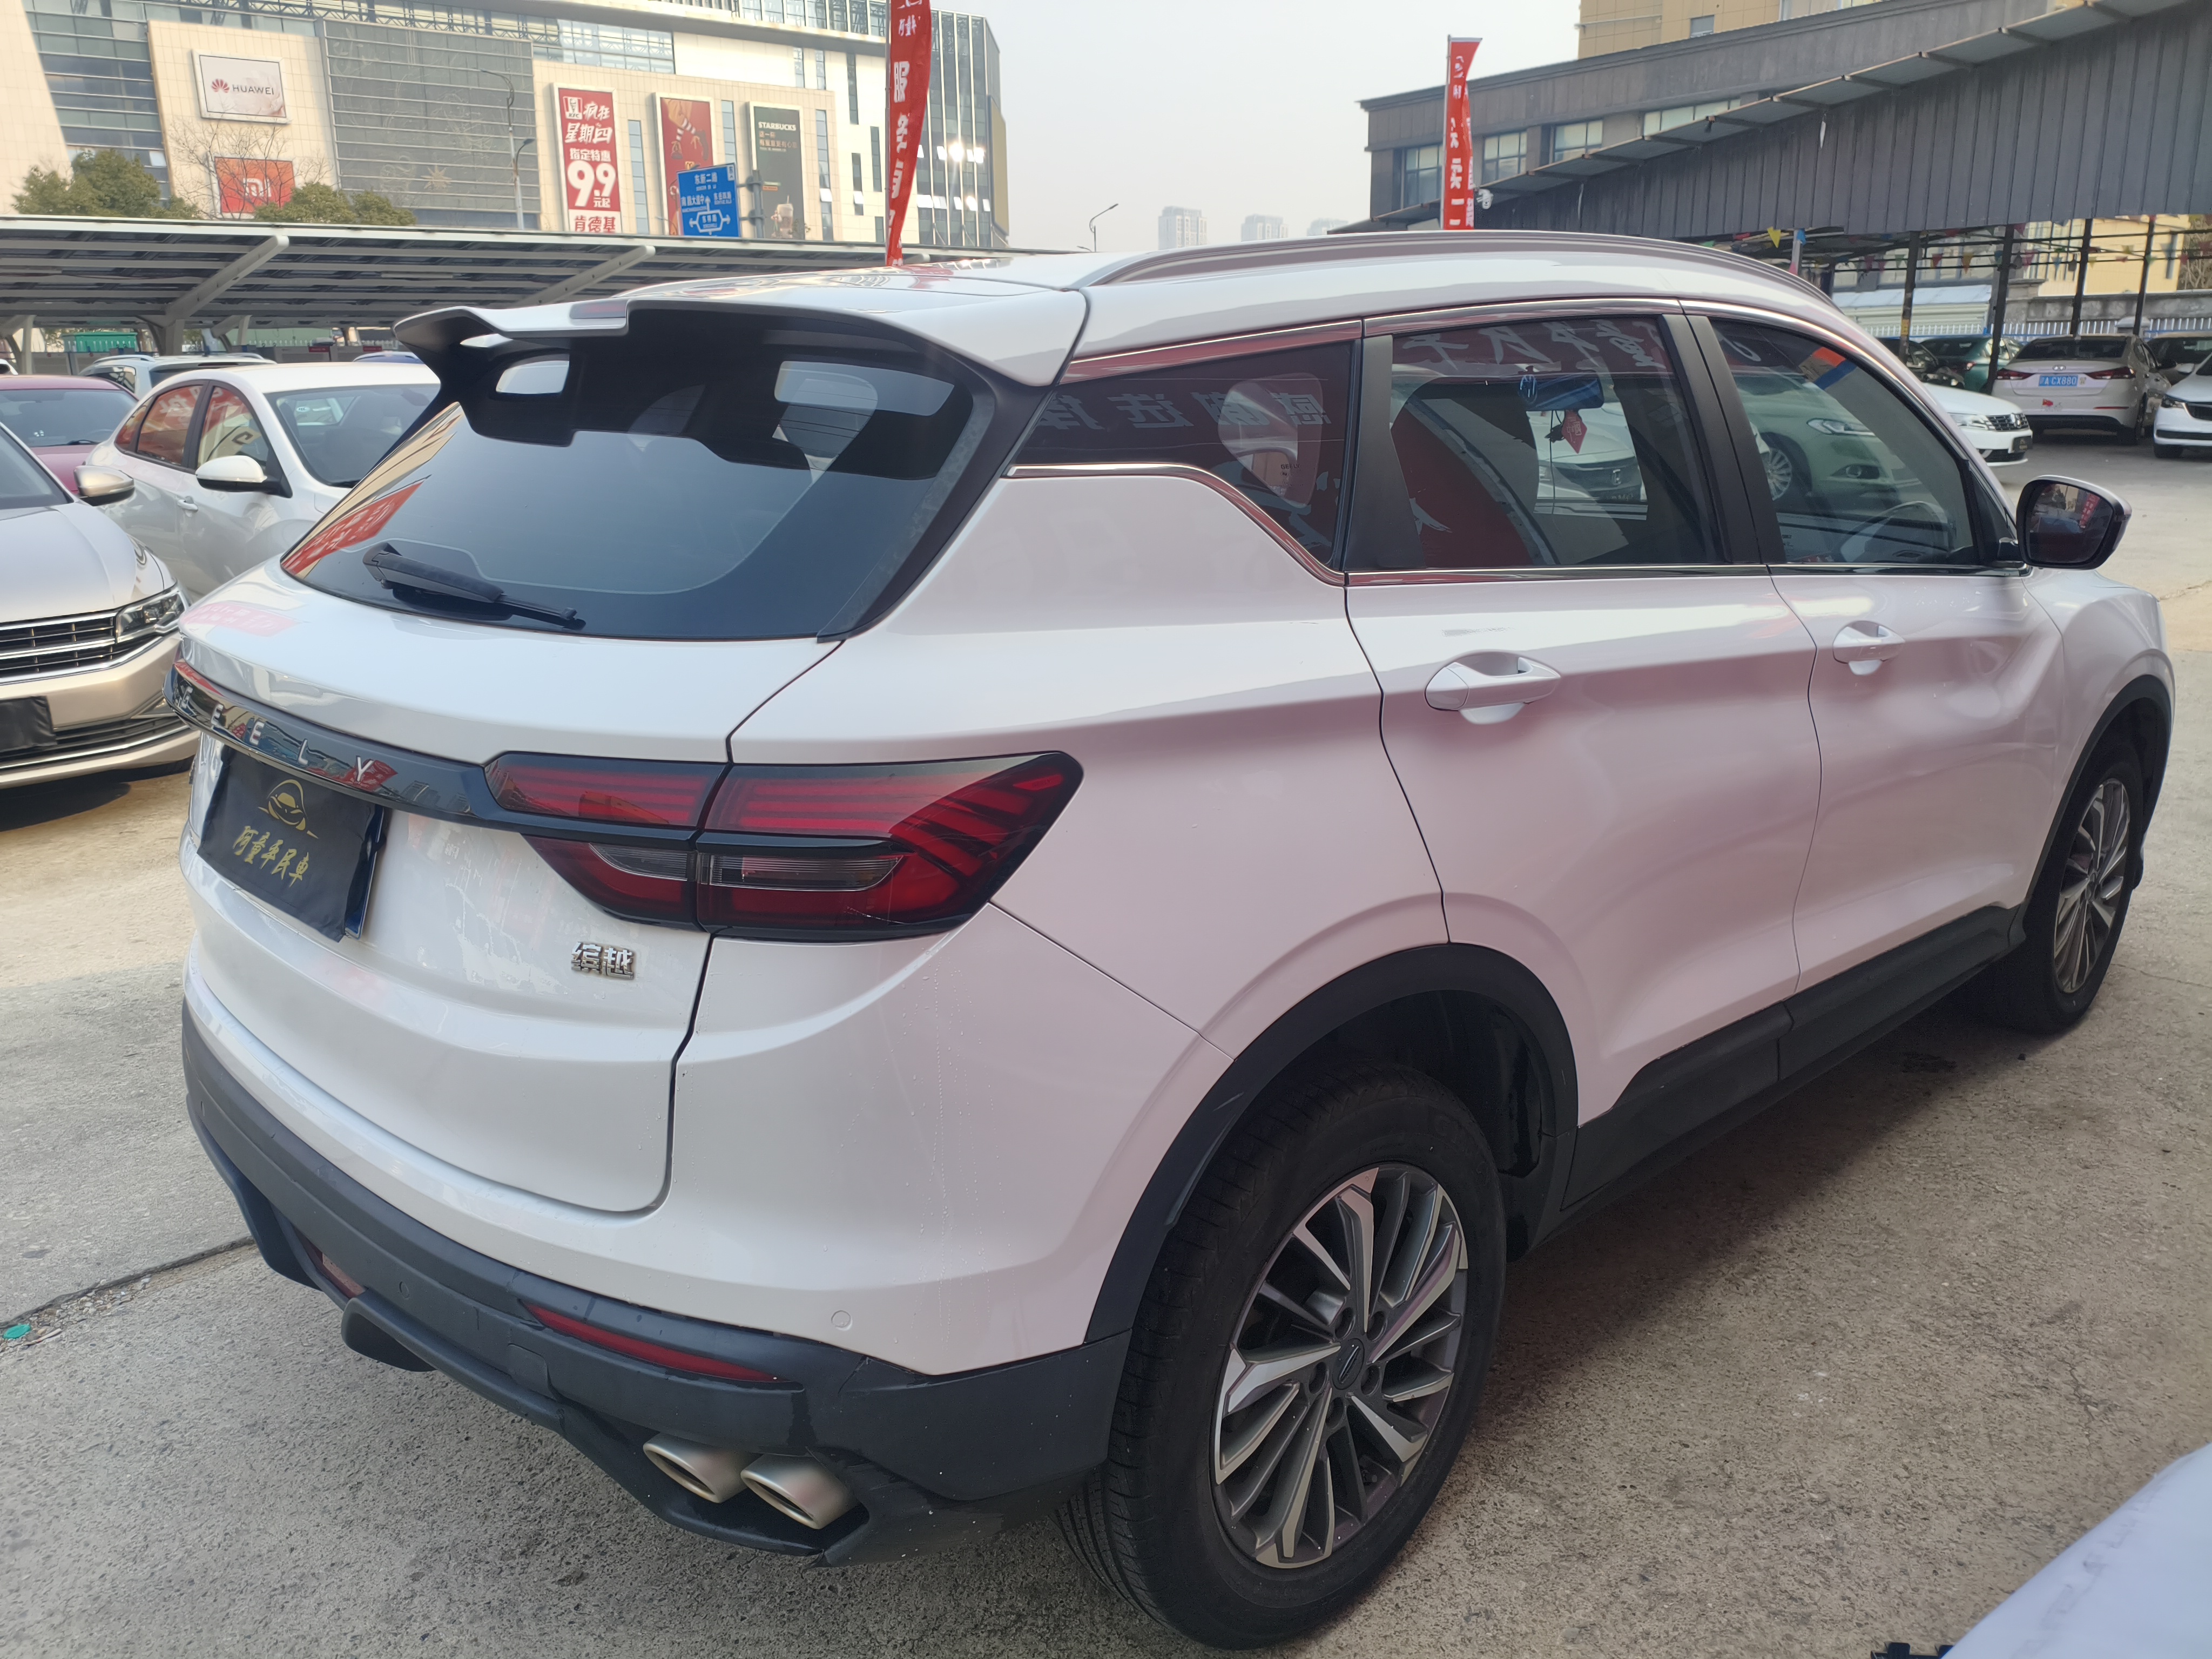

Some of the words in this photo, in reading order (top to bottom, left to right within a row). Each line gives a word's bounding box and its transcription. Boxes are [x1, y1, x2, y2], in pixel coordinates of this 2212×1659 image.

[233, 84, 274, 95] HUAWEI
[564, 122, 612, 144] 星期四
[574, 215, 616, 233] 肯德基
[176, 685, 374, 783] GEELY
[571, 941, 635, 980] 缤越
